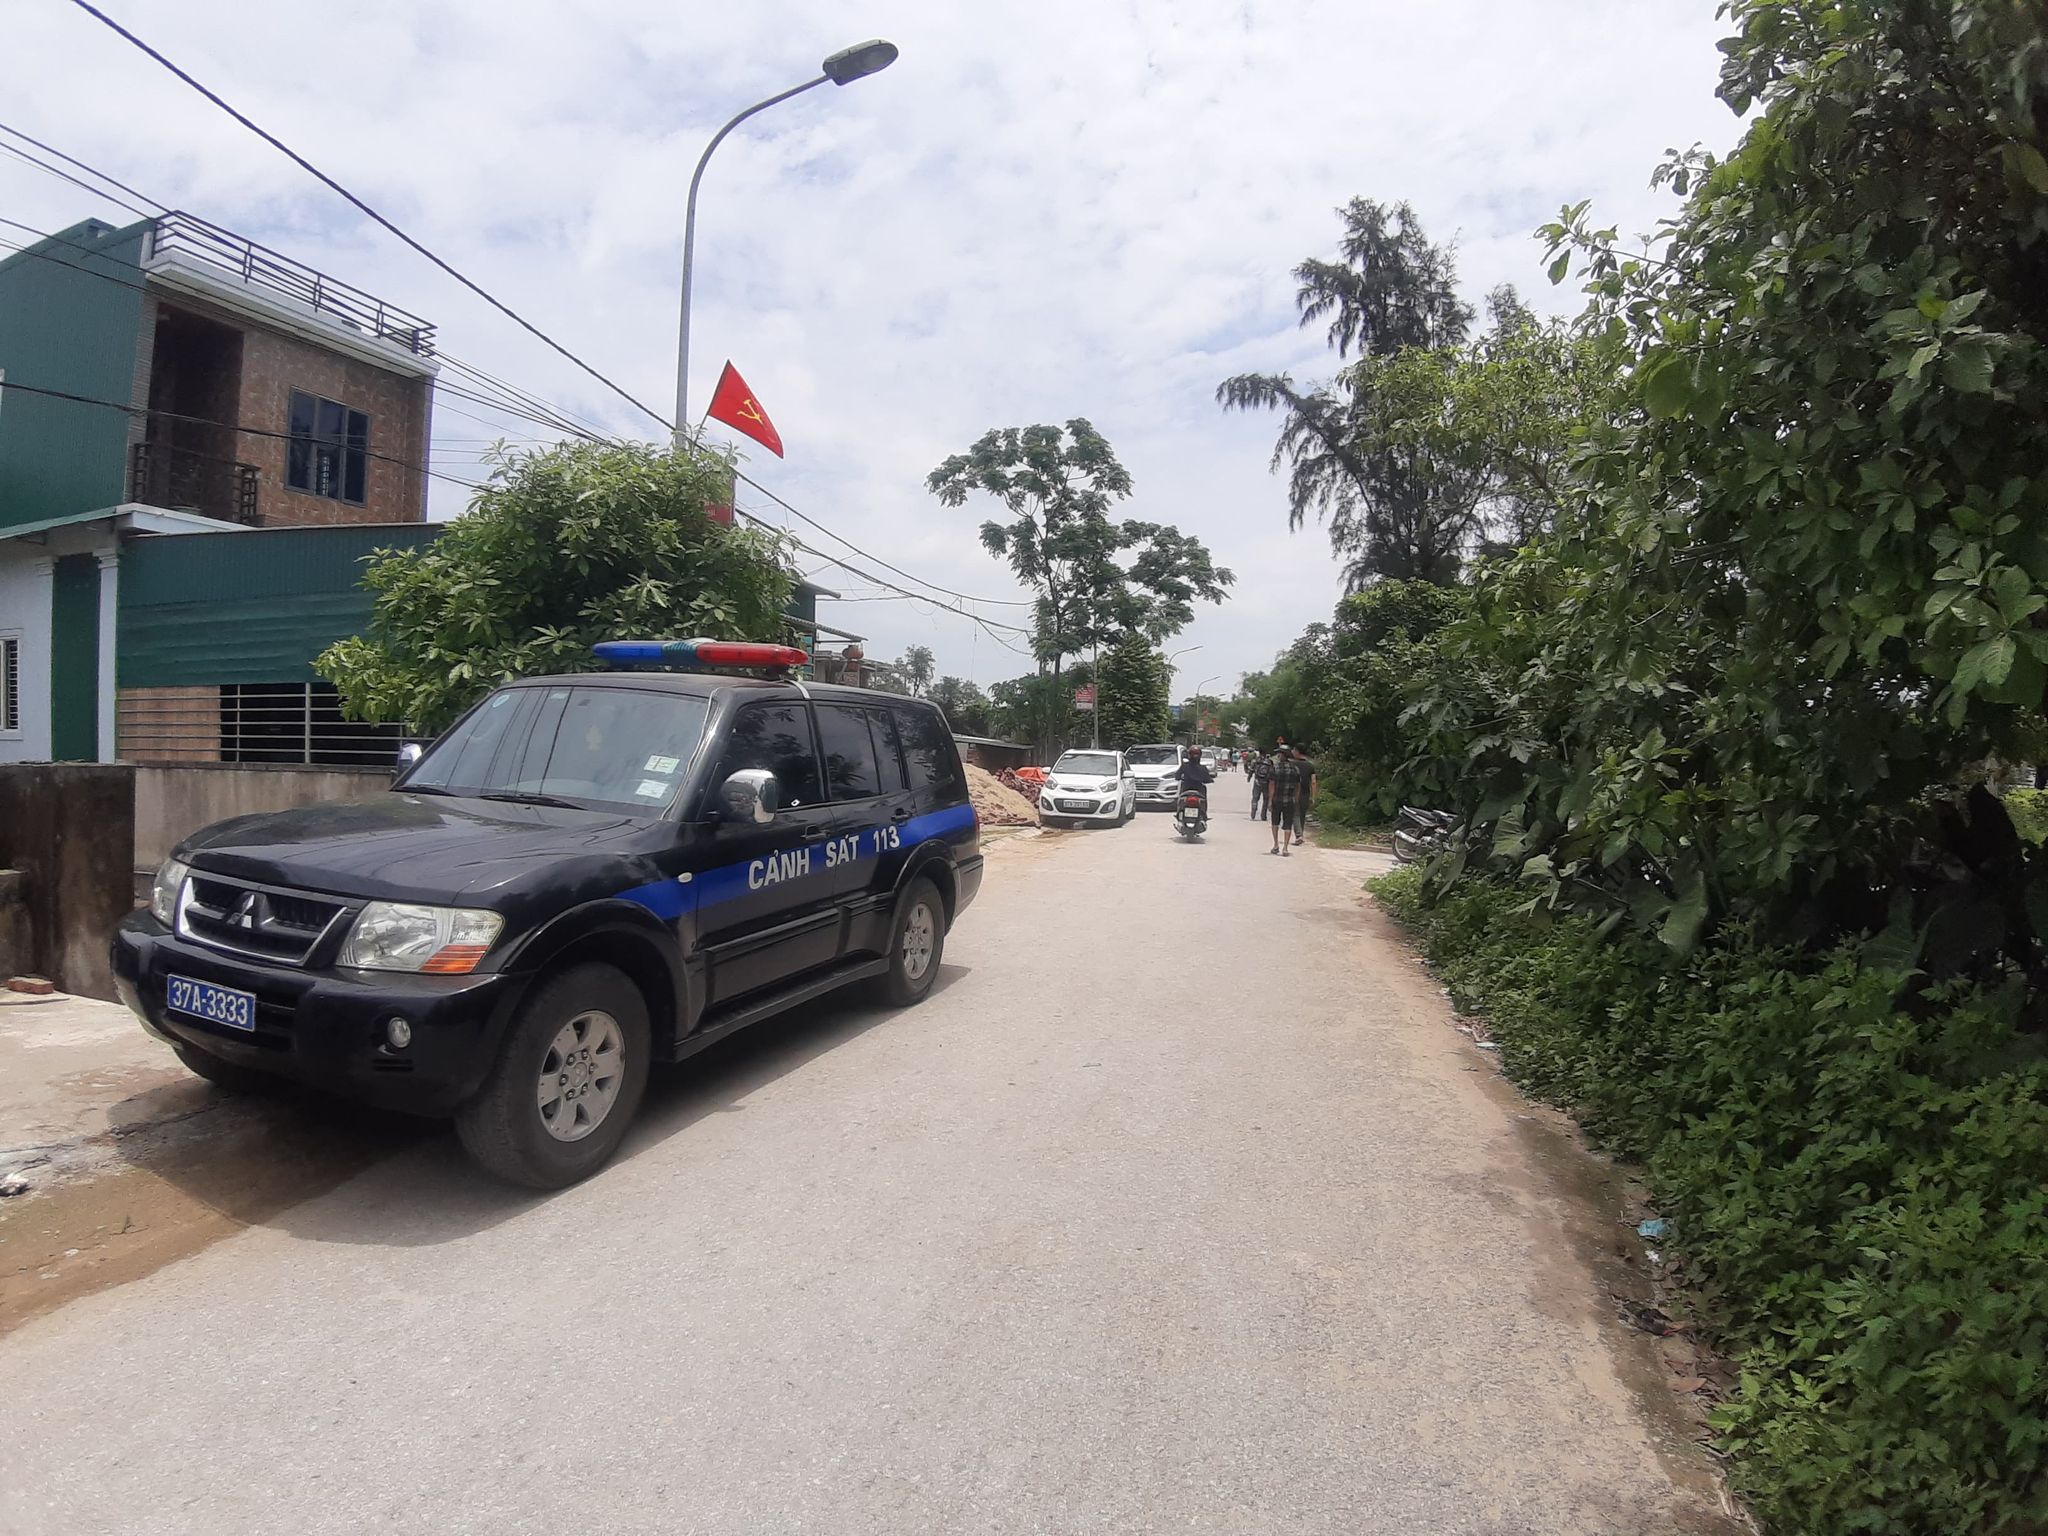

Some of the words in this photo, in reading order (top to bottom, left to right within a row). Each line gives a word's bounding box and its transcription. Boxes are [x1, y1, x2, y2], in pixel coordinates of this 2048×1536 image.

[748, 847, 810, 890] CẢNH
[825, 833, 860, 868] SÁT
[873, 825, 901, 853] 113
[172, 980, 248, 1025] 37A-3333
